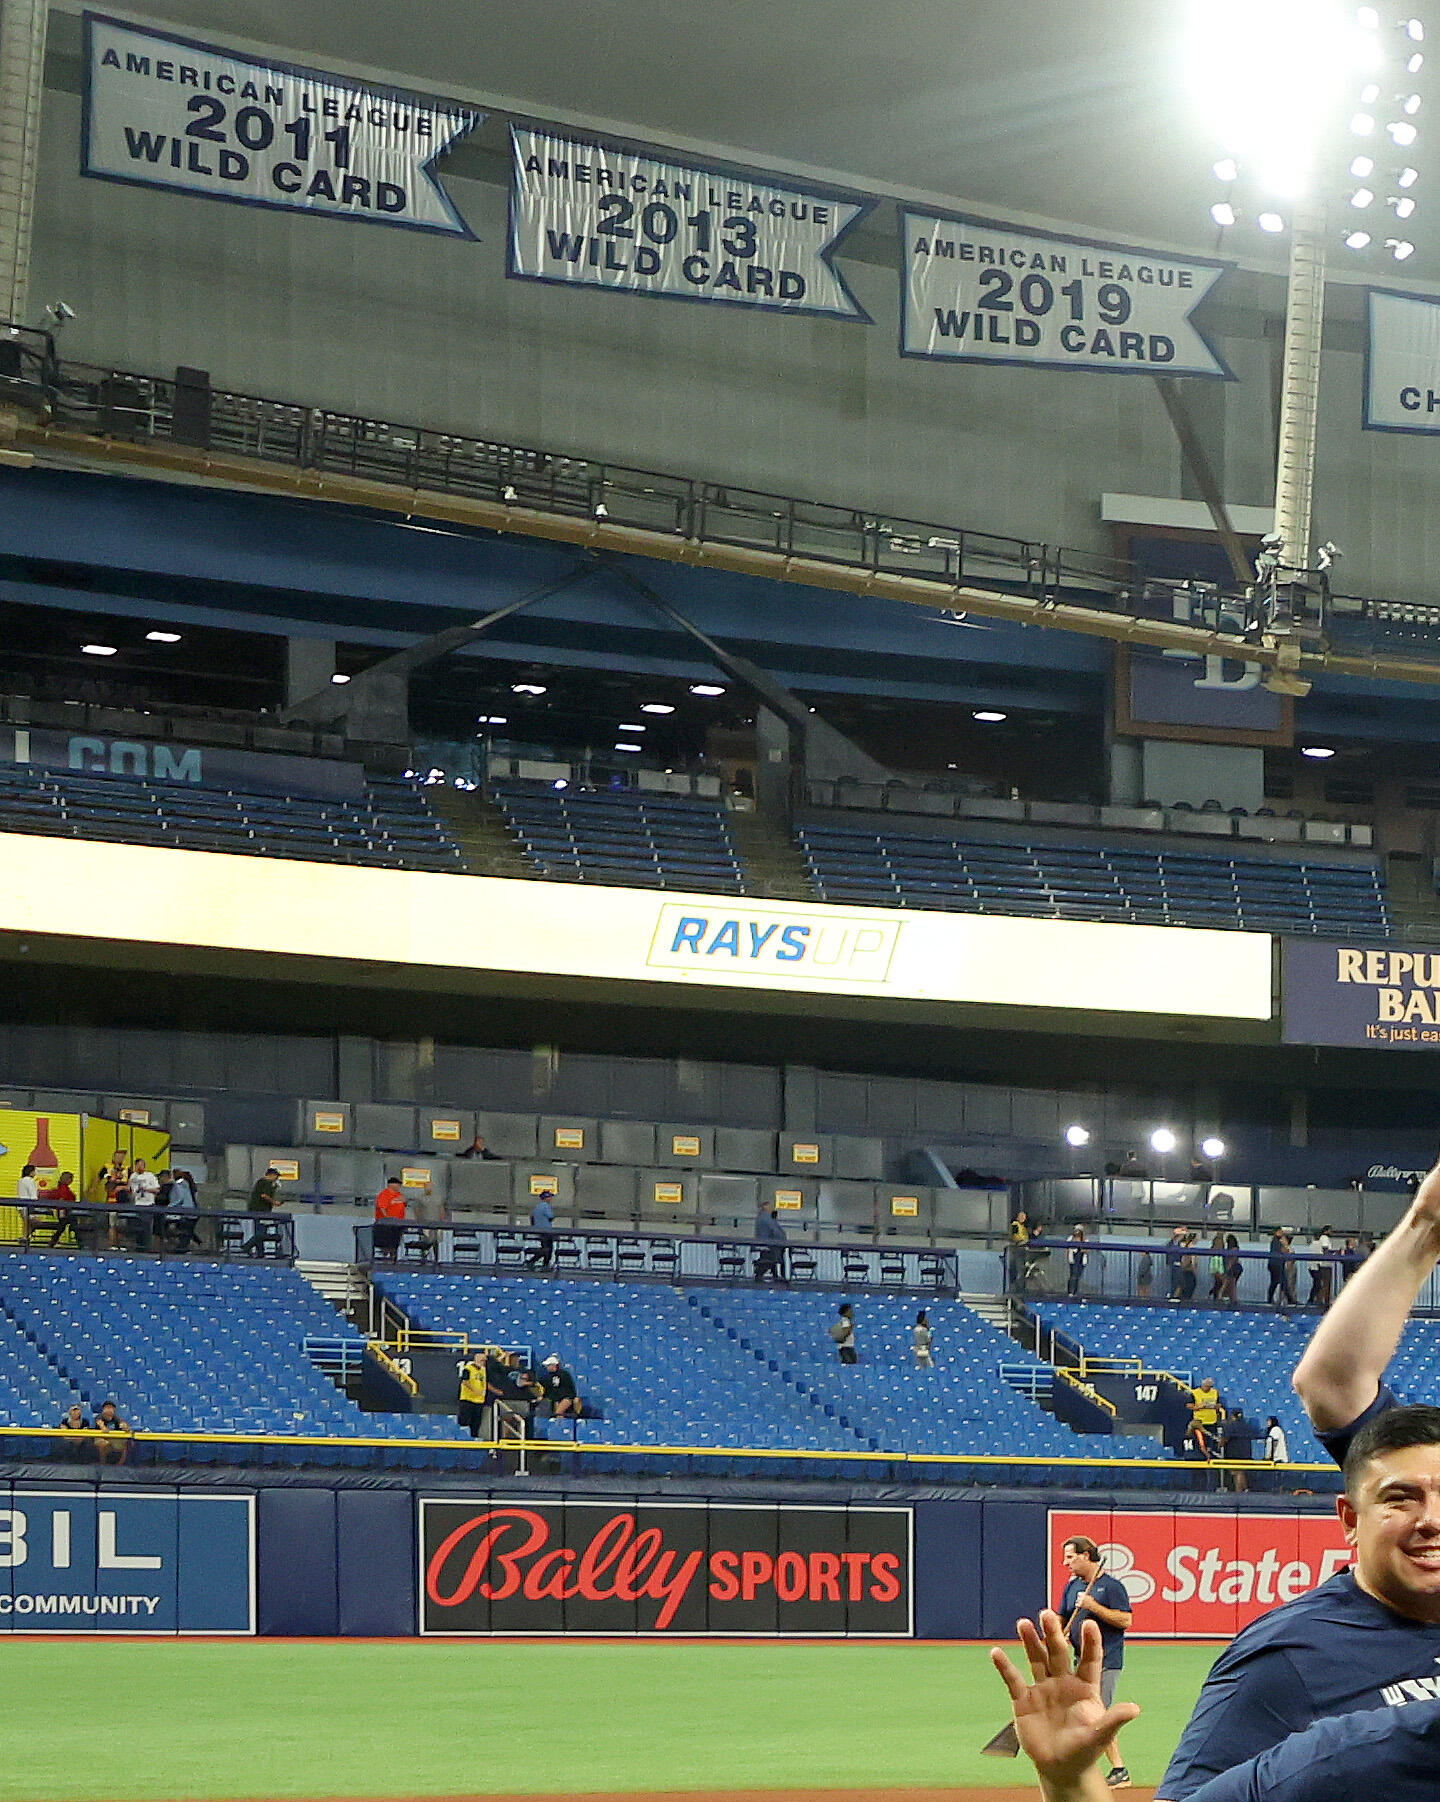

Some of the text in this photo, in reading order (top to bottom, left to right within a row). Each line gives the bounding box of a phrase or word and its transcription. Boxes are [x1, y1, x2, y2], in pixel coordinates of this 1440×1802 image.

[102, 48, 432, 136] AMERICAN LEAGUE
[186, 95, 349, 168] 2011
[125, 128, 406, 212] WILD CARD
[526, 155, 828, 224] AMERICAN LEAGUE
[597, 194, 757, 258] 2013
[547, 230, 805, 299] WILD CARD
[915, 238, 1192, 288] AMERICAN LEAGUE
[979, 268, 1131, 325] 2019
[935, 308, 1175, 362] WILD CARD
[1366, 1024, 1387, 1040] It's
[1390, 1027, 1418, 1041] just
[1135, 1385, 1158, 1401] 147
[426, 1508, 899, 1630] Bally SPORTS
[1162, 1545, 1311, 1605] State
[0, 1594, 160, 1614] COMMUNITY
